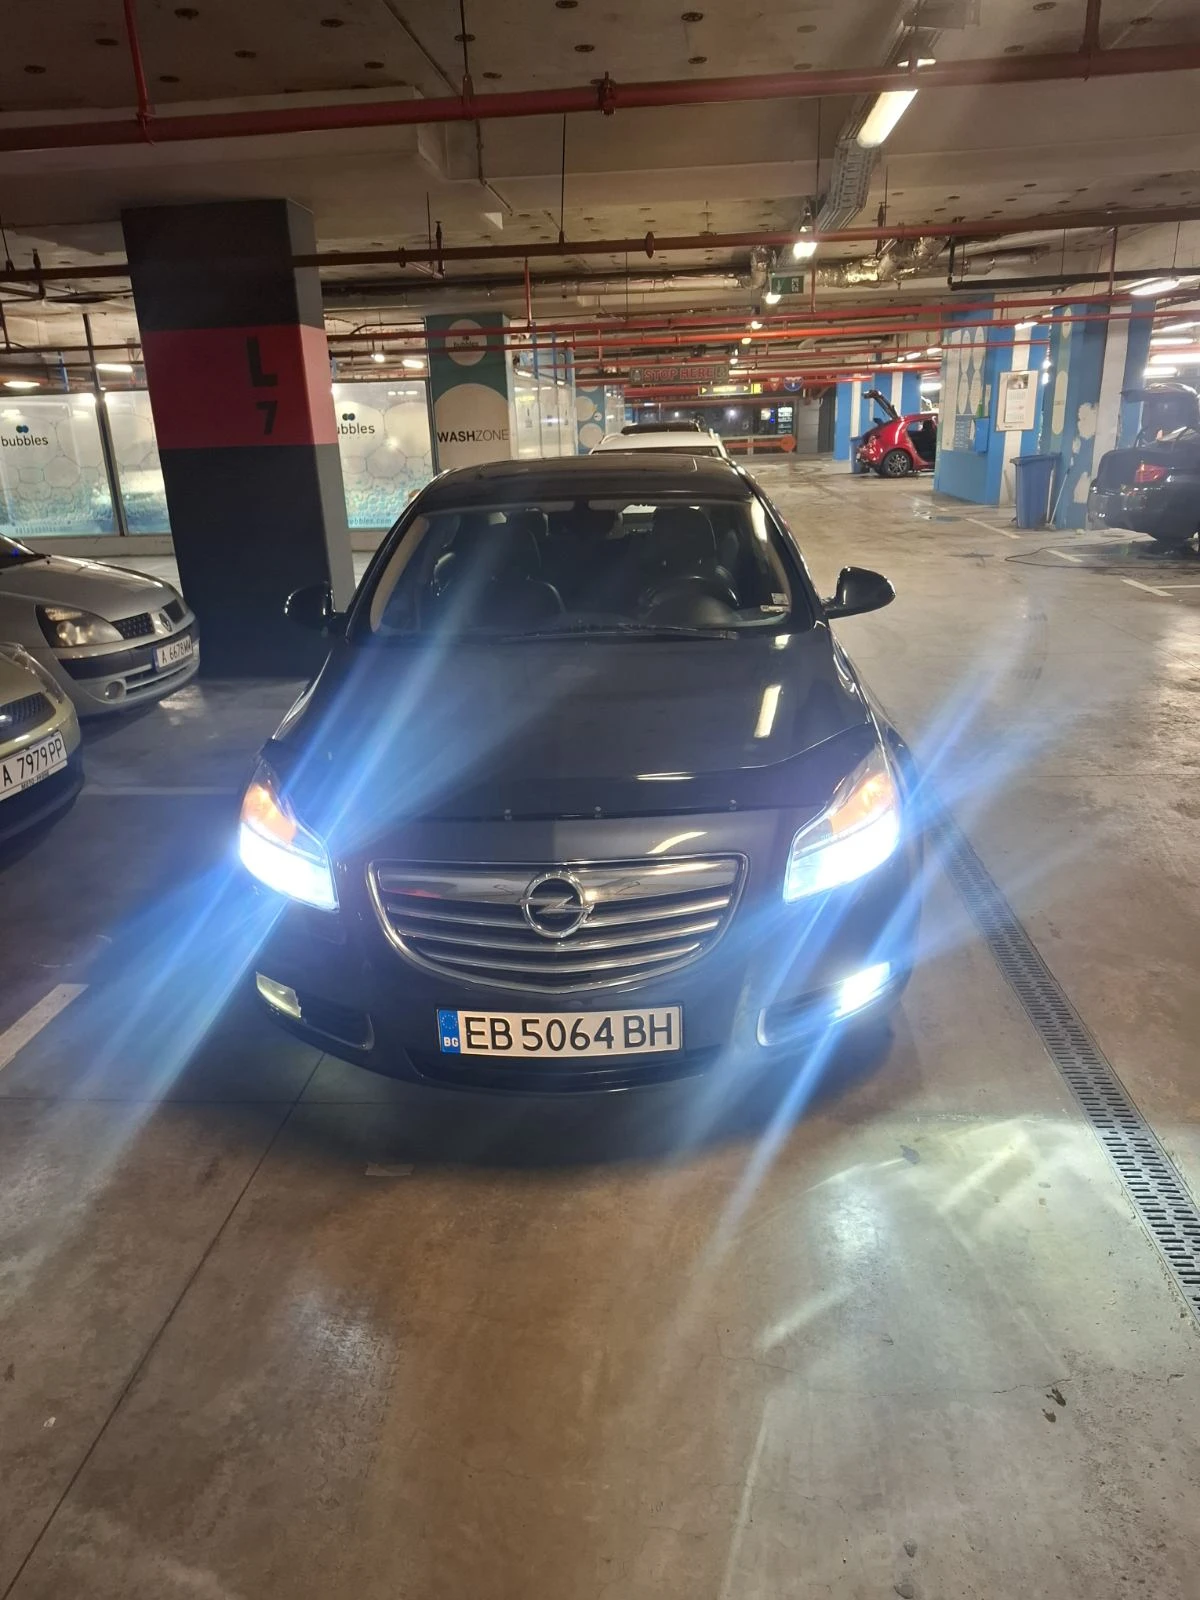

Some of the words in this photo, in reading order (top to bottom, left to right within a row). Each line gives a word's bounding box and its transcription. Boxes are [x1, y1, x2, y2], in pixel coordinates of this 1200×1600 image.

[246, 335, 279, 388] L
[644, 367, 678, 381] STOP
[680, 366, 714, 380] HERE
[255, 400, 278, 435] 7
[1, 435, 49, 447] bubbles
[437, 428, 509, 442] WASHZONE
[3, 764, 13, 788] A
[443, 1036, 459, 1047] BG
[464, 1016, 513, 1051] EB
[521, 1016, 615, 1051] 5064
[623, 1013, 672, 1048] BH
